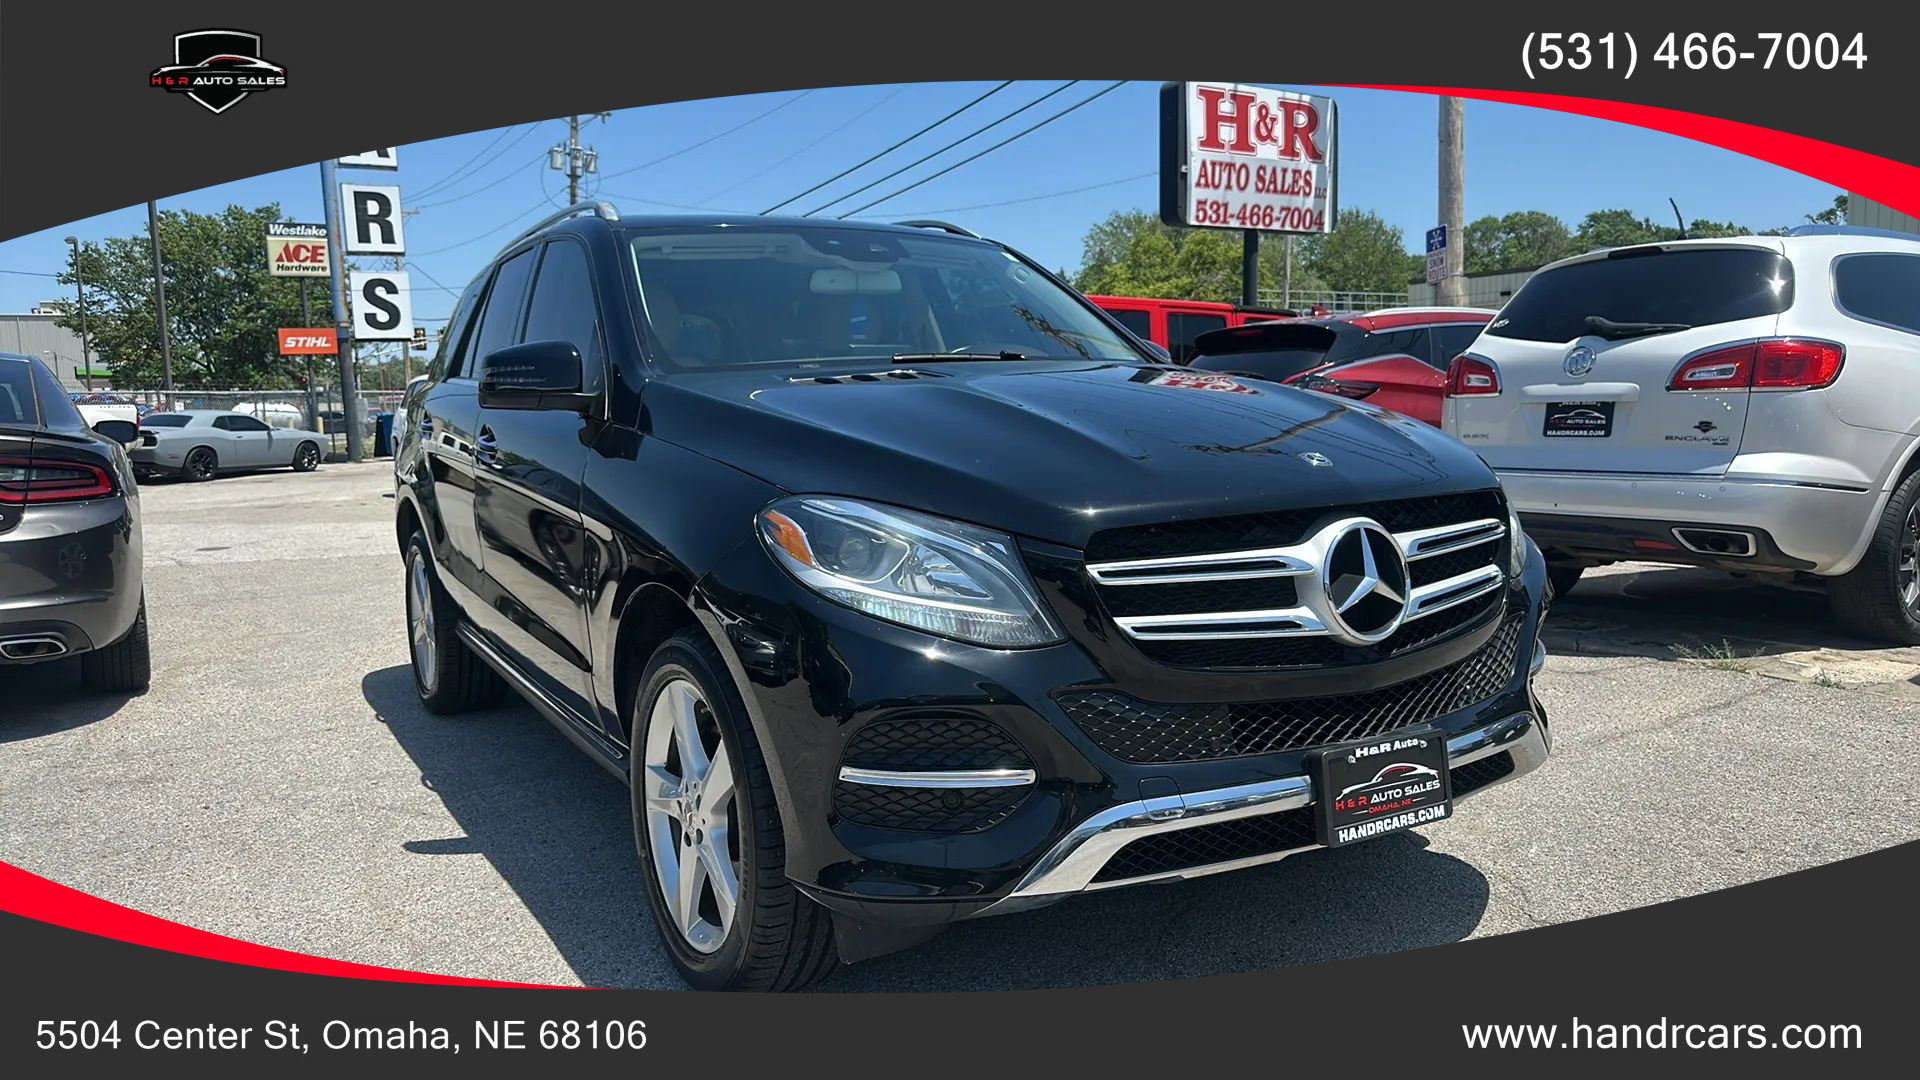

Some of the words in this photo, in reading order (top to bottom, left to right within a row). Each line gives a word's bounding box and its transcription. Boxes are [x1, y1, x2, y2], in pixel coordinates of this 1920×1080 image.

[1196, 85, 1324, 164] H&R
[1195, 159, 1250, 192] AUTO
[1255, 164, 1313, 198] SALES
[1195, 198, 1325, 231] 531-466-7004
[268, 223, 328, 237] Westlake
[275, 241, 326, 264] ACE
[276, 264, 328, 273] Hardware
[285, 336, 331, 348] STIHL
[1355, 742, 1392, 758] H&R
[1393, 738, 1419, 751] Auto
[1370, 788, 1403, 804] AUTO
[1404, 779, 1441, 796] SALES
[1338, 804, 1445, 843] HANDRCARS.COM
